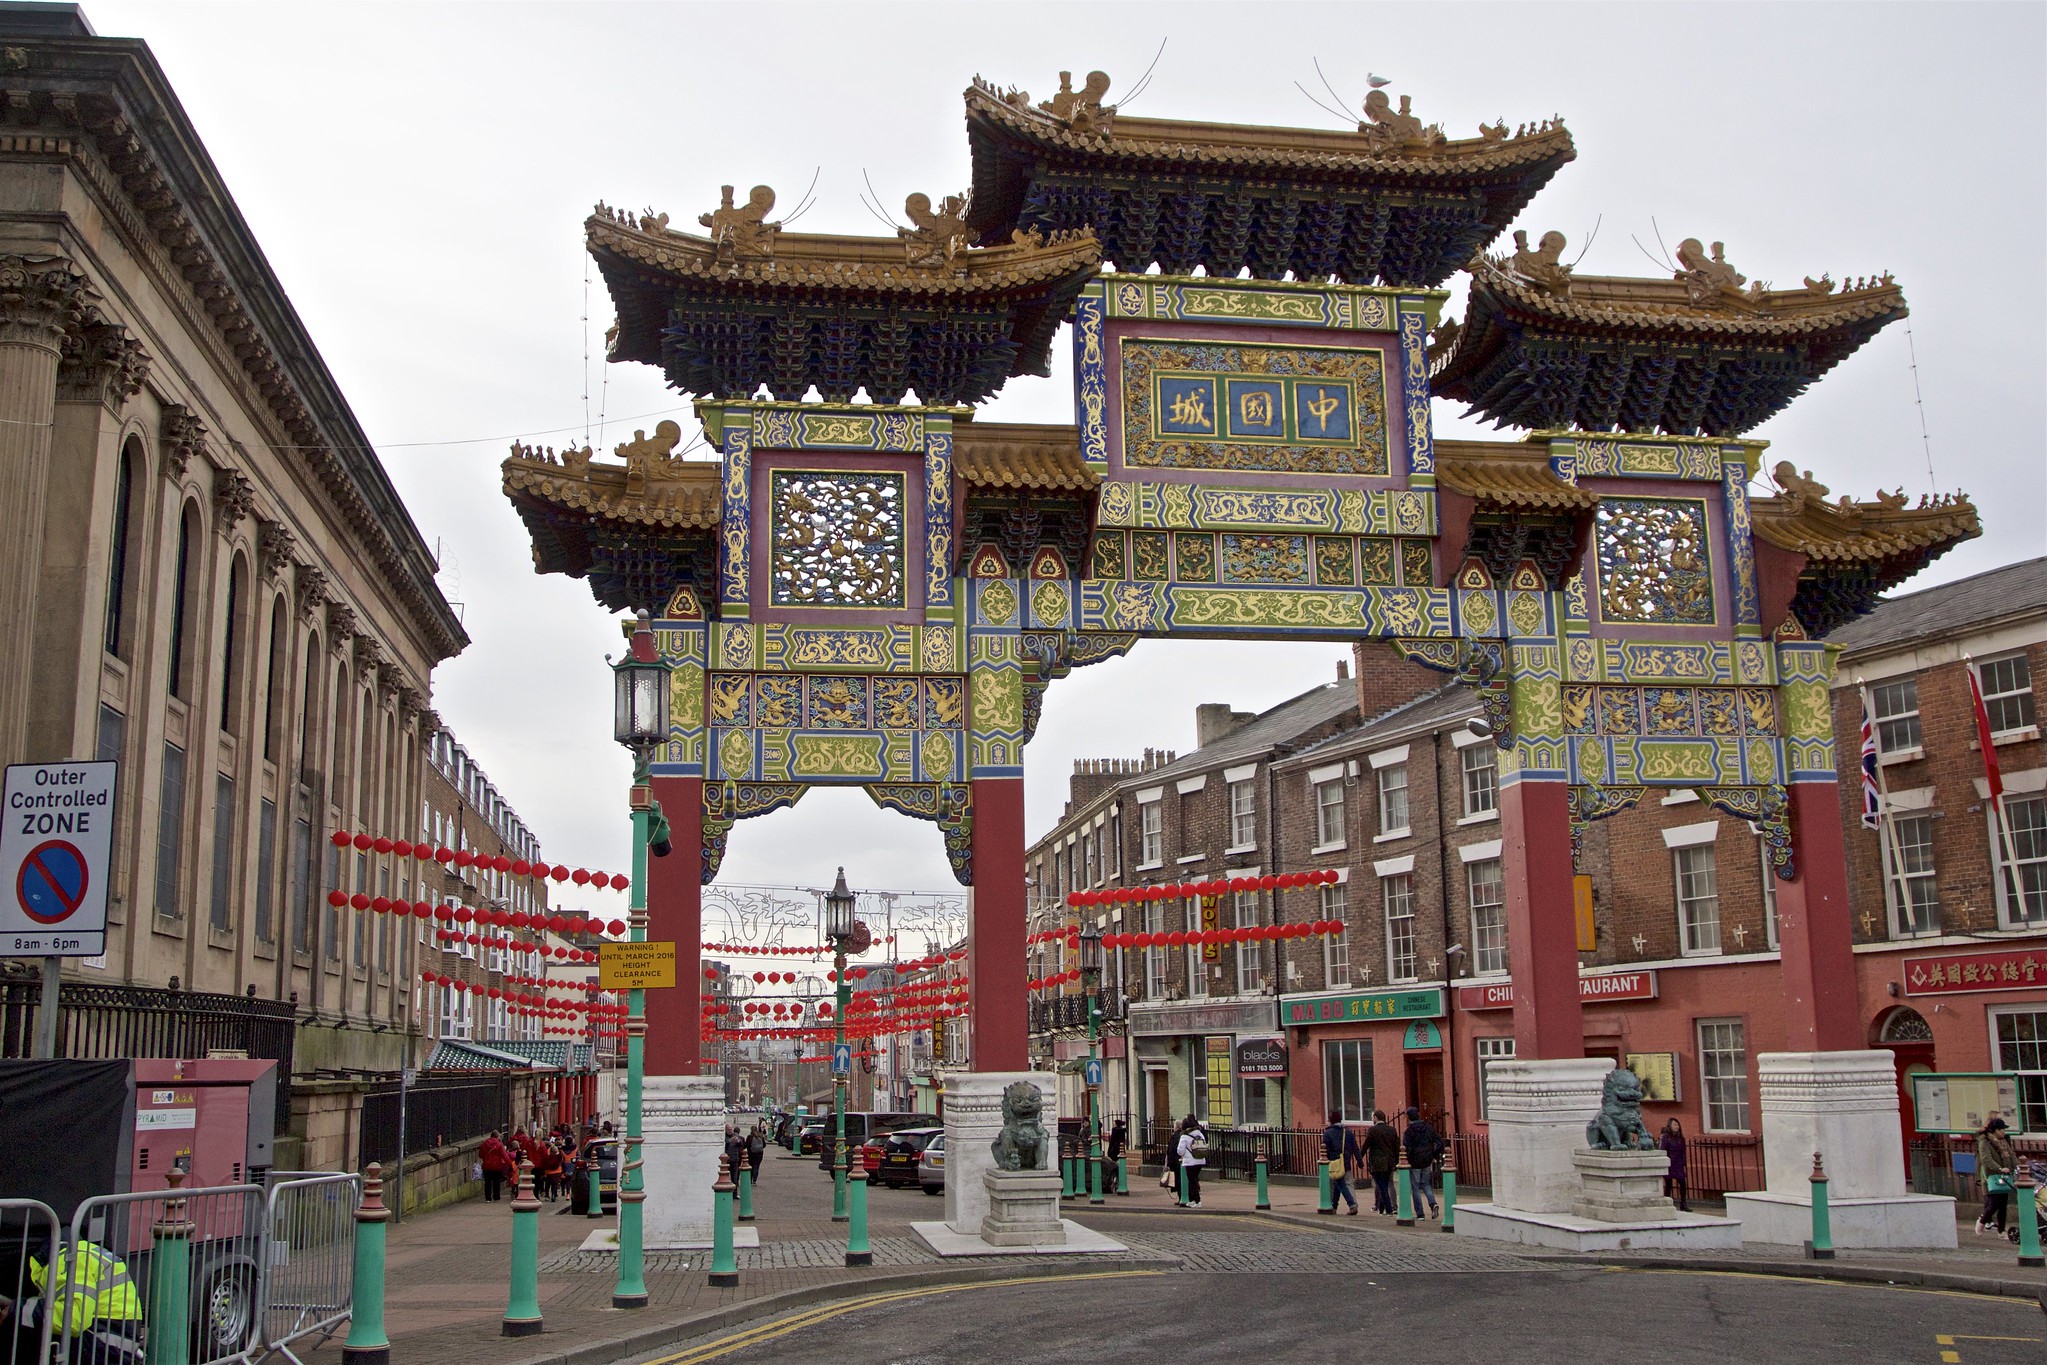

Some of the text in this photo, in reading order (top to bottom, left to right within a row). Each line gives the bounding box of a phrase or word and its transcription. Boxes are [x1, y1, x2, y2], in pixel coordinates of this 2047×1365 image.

[35, 769, 87, 786] Outer
[11, 789, 108, 810] Controlled
[22, 812, 91, 835] ZONE
[600, 953, 623, 961] UNTIL
[622, 961, 651, 969] HEIGHT
[613, 970, 662, 978] CLEARANCE
[1408, 996, 1426, 1004] CHINESE
[1292, 1001, 1344, 1021] MA BO
[1403, 1004, 1431, 1012] RESTAURANT
[1243, 1045, 1280, 1061] blacks
